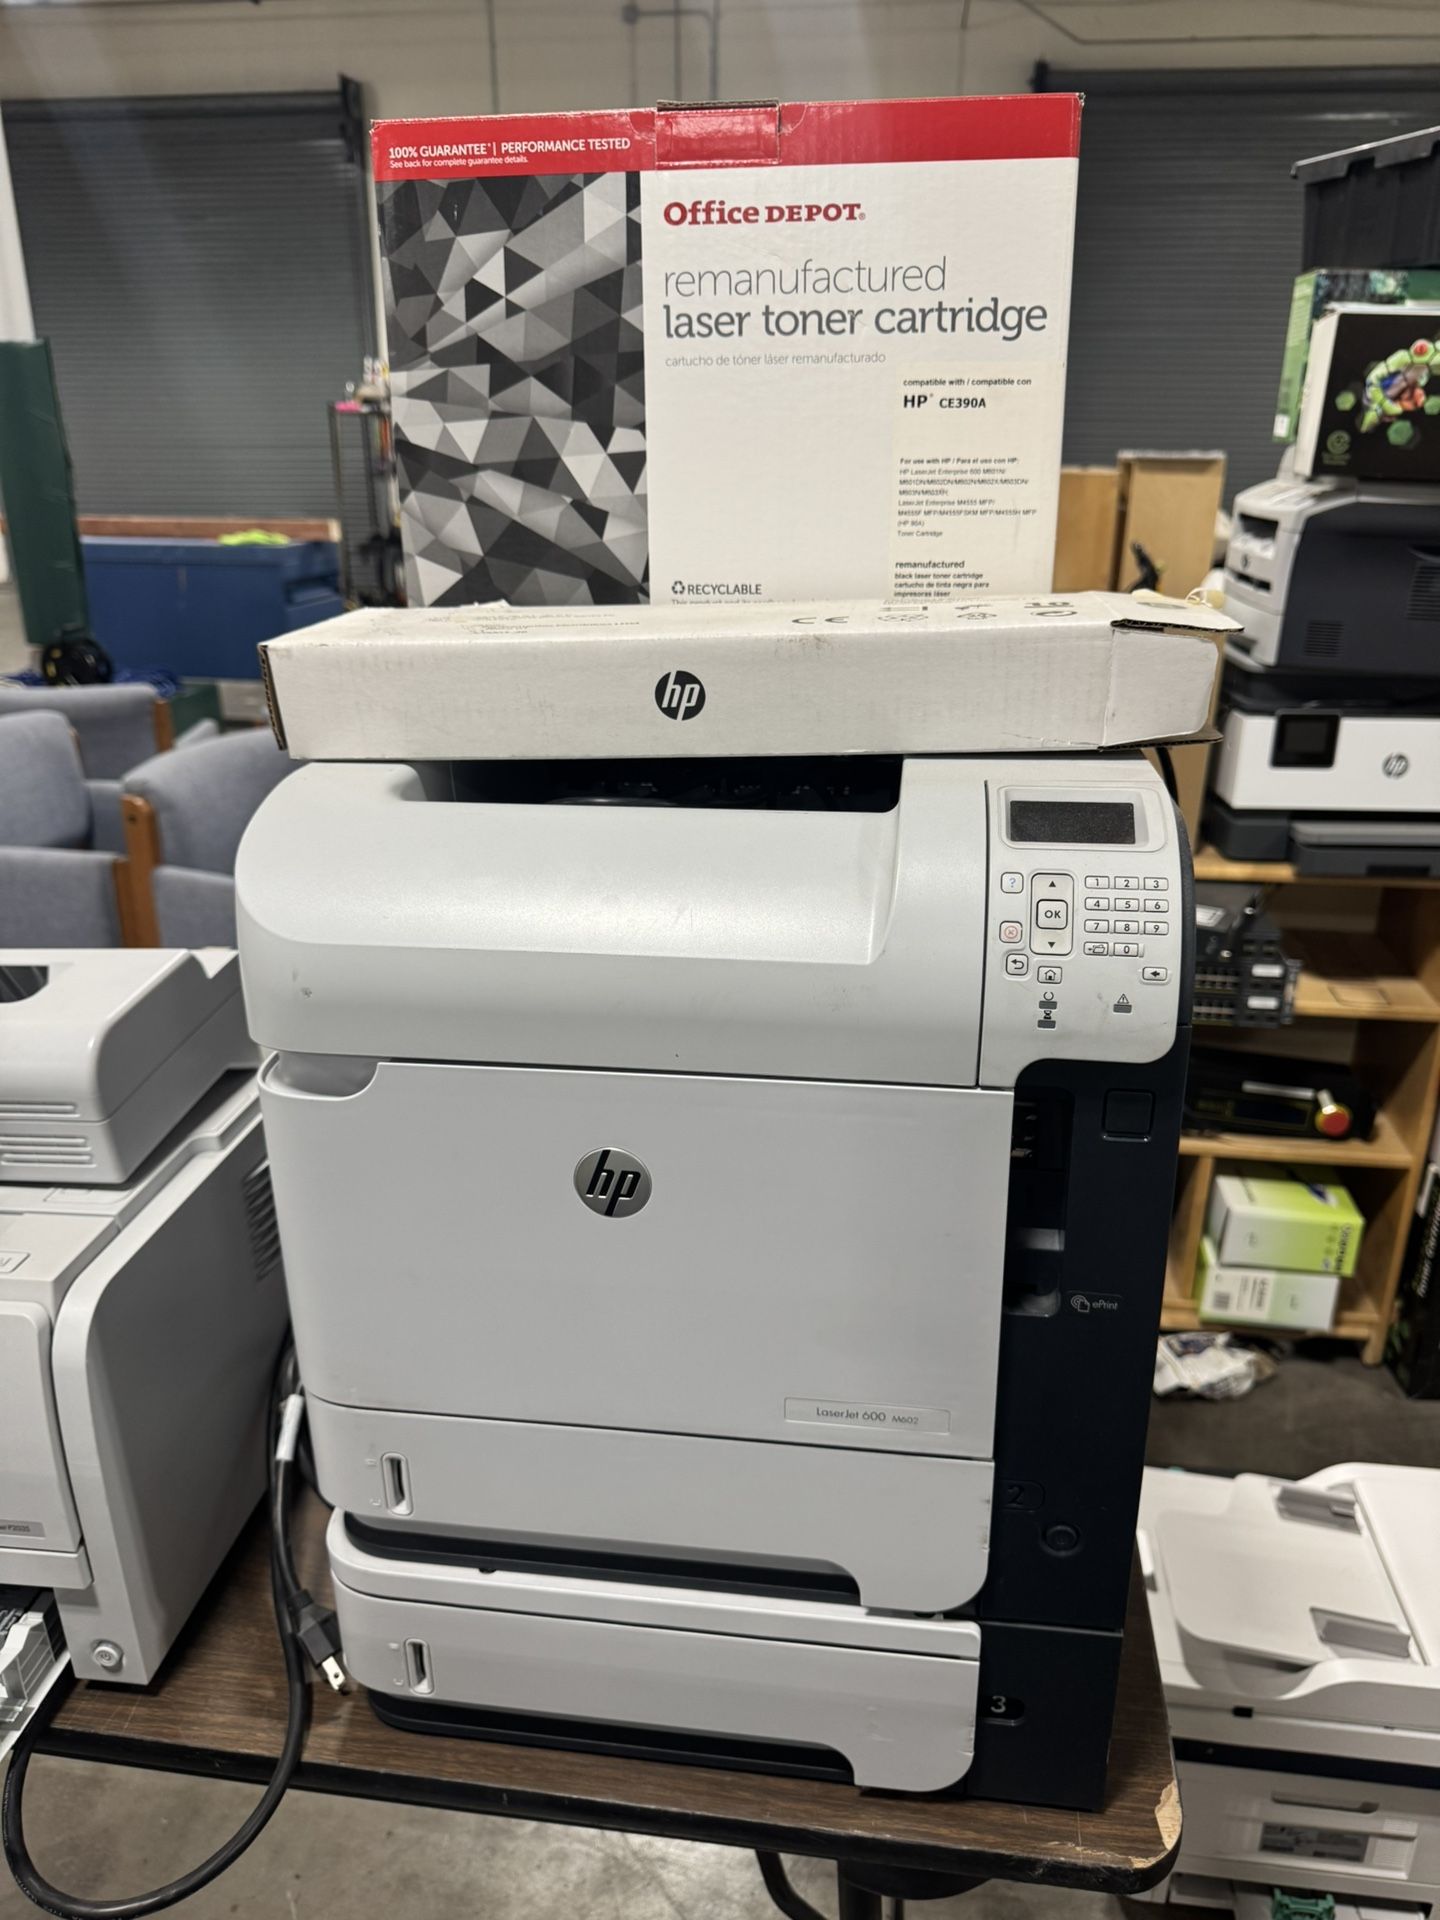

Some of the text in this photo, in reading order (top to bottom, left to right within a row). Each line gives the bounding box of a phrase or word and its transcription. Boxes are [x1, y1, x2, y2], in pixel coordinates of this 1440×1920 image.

[388, 146, 418, 159] 100%
[500, 139, 586, 154] PERFORMANCE
[587, 137, 631, 150] TESTED
[389, 155, 528, 169] See back for complete guarantee details.
[663, 200, 759, 226] Office
[664, 255, 946, 297] remanufactured
[663, 297, 1048, 341] laser toner cartridge
[665, 351, 886, 367] cartucho de tóner láser remanufacturado
[903, 378, 946, 387] compatible
[948, 378, 965, 386] with
[971, 377, 1015, 387] compatible
[1016, 378, 1032, 386] con
[939, 397, 987, 409] CE390A
[900, 457, 911, 465] For
[895, 560, 965, 569] remanufactured
[687, 583, 762, 596] RECYCLABLE
[659, 670, 703, 720] hp
[1094, 878, 1160, 888] 1 2 3
[1094, 900, 1161, 910] 4 5 6
[1044, 909, 1061, 919] OK
[1094, 922, 1160, 933] 7 8 9
[1123, 945, 1130, 954] 0
[582, 1148, 645, 1218] hp
[1092, 1299, 1118, 1310] ePrint
[816, 1407, 919, 1425] LaserJet 600 M602
[1007, 1485, 1024, 1507] 2
[990, 1695, 1006, 1713] 3
